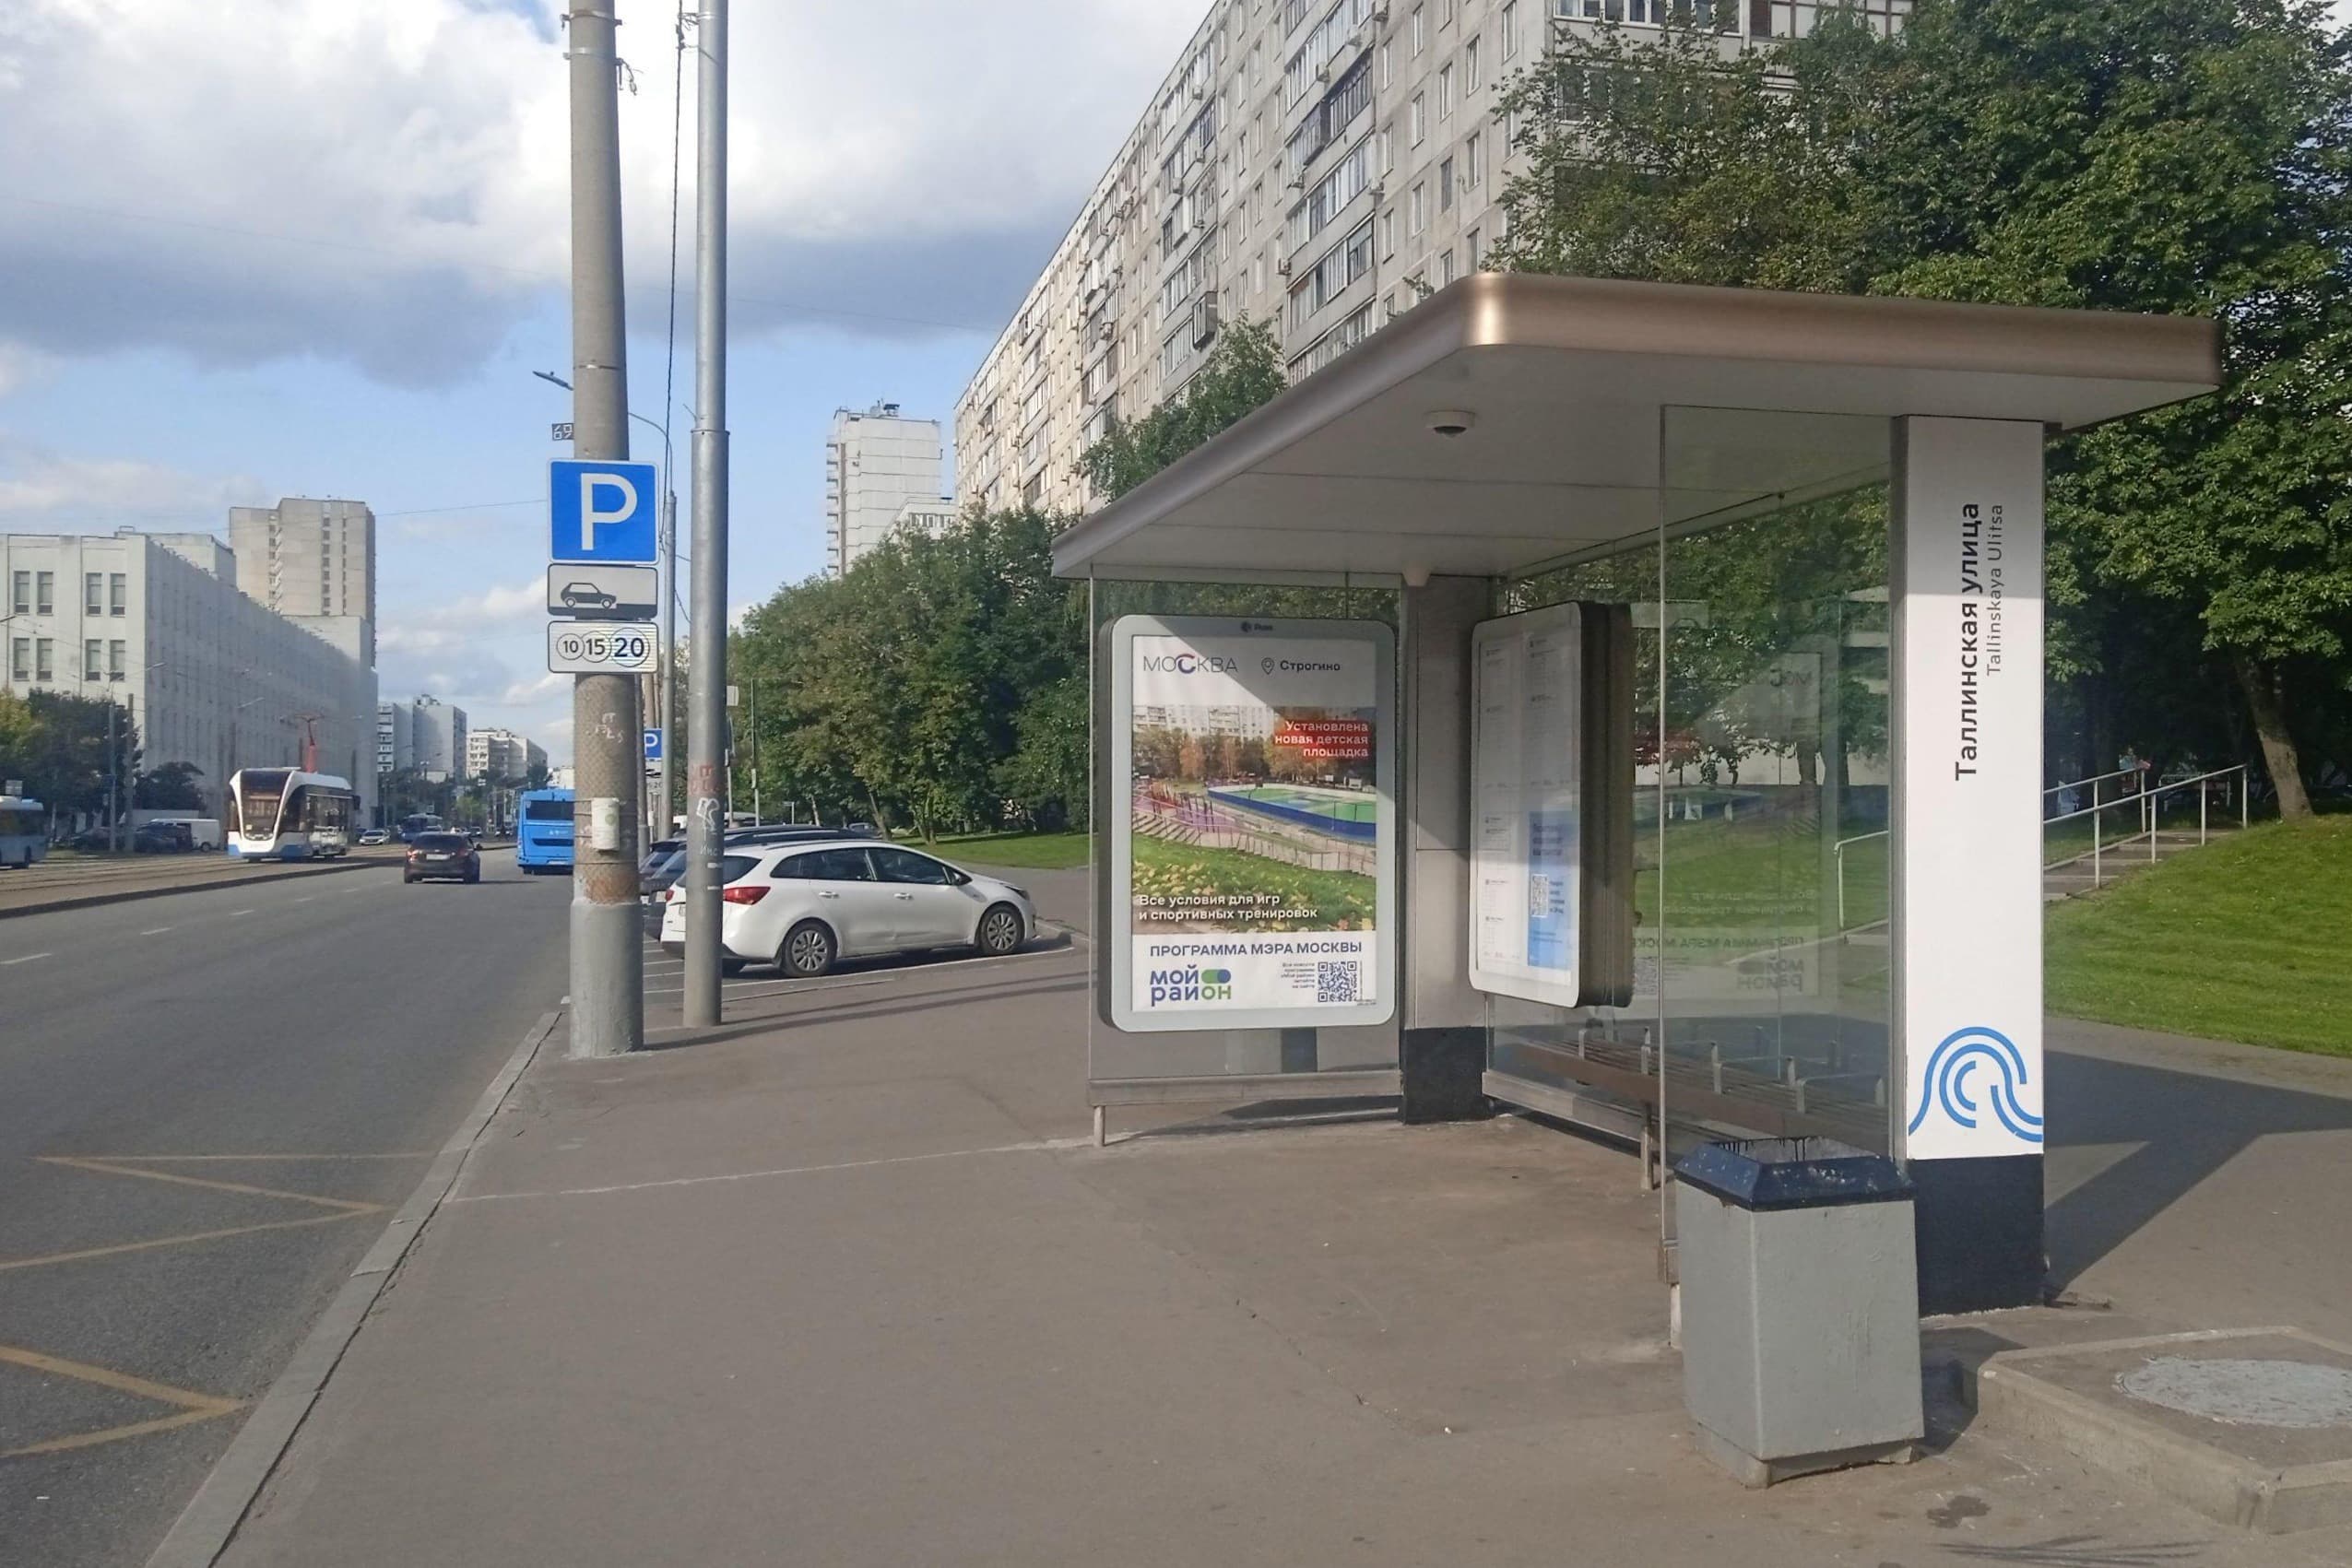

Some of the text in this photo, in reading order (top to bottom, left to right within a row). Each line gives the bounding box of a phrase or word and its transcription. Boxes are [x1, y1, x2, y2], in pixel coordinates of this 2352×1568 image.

[581, 473, 638, 551] P
[1987, 504, 2004, 677] Tallinskaya Ulitsa
[562, 637, 644, 657] 10 15 20
[1955, 503, 1982, 782] Таллинская улица
[1142, 654, 1238, 674] МОСКВА
[1280, 660, 1341, 674] Строгино
[1285, 721, 1368, 731] Установлена
[1275, 737, 1368, 746] новая детская
[1303, 749, 1368, 759] площадка
[1140, 895, 1281, 907] Все условия для игр
[1139, 906, 1318, 920] и спортивных тренировок
[1150, 942, 1362, 957] ПРОГРАММА МЭРА МОСКВЫ
[1150, 964, 1199, 984] мой
